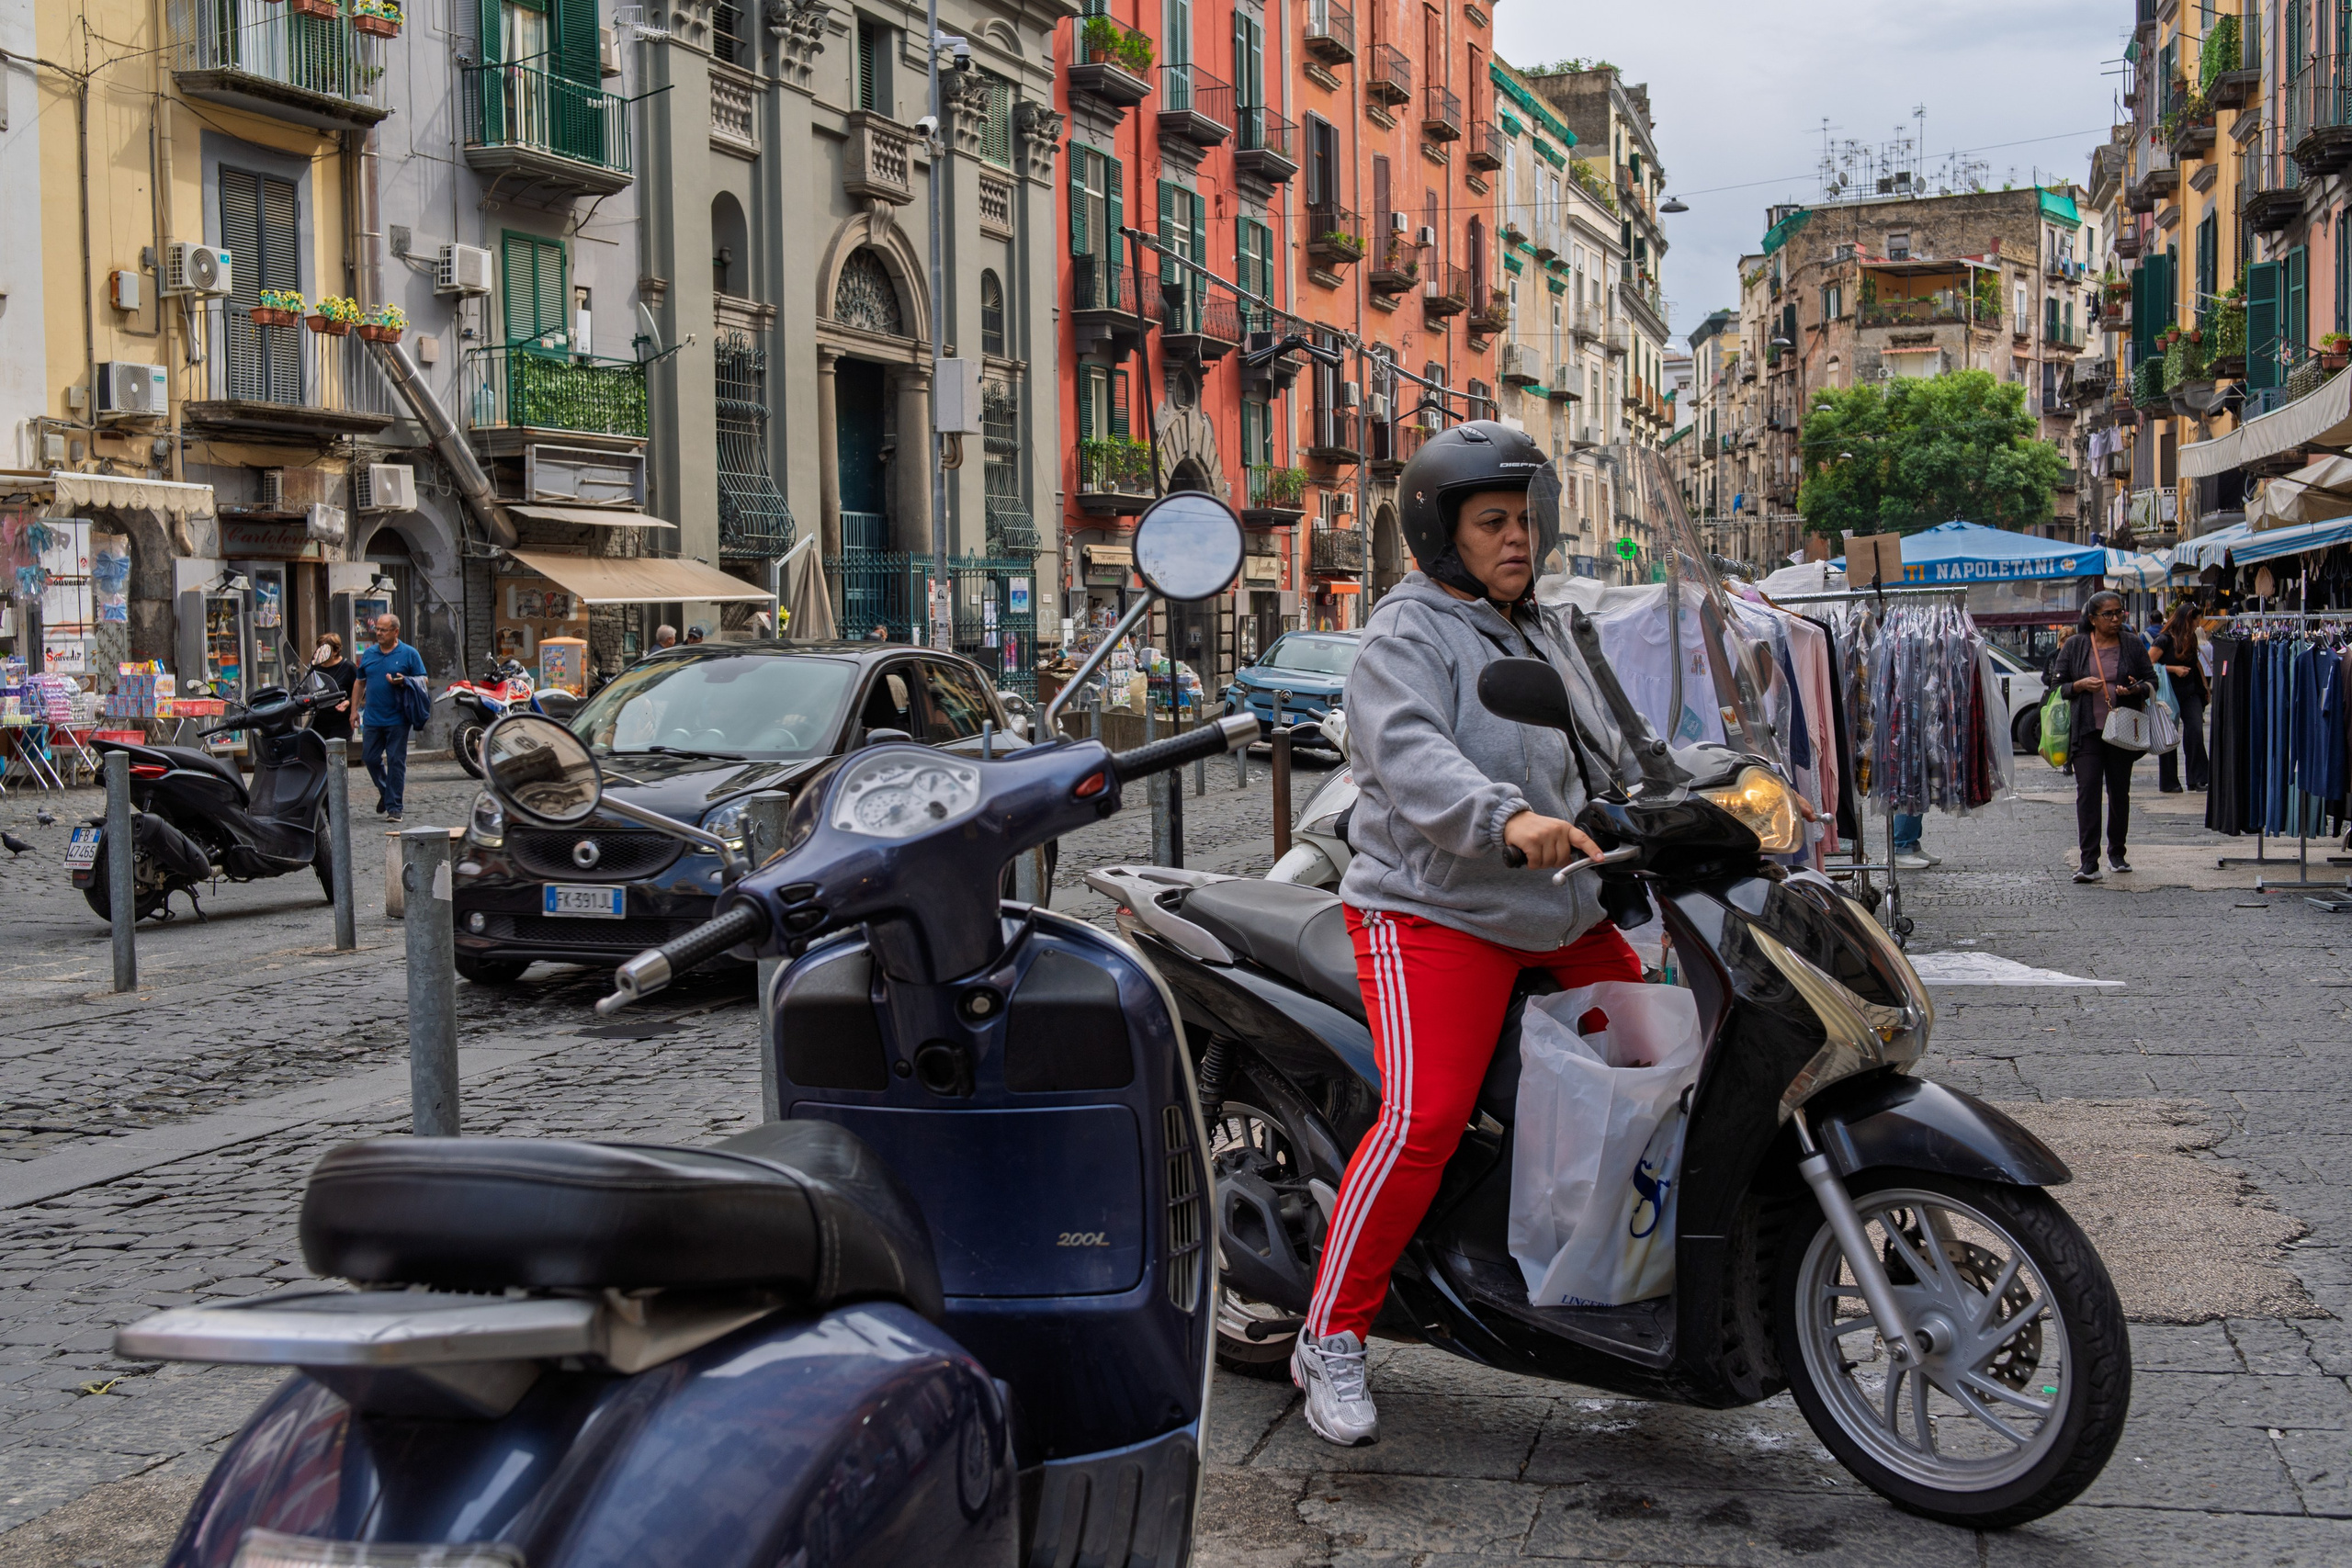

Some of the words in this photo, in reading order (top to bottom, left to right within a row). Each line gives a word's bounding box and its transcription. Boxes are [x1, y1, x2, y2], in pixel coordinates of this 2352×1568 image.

[1903, 564, 1925, 581] TI
[1936, 558, 2055, 581] NAPOLETANI
[46, 649, 81, 661] Souvenir
[78, 829, 91, 841] FB
[69, 845, 96, 859] 47465
[1057, 1232, 1110, 1246] 200L
